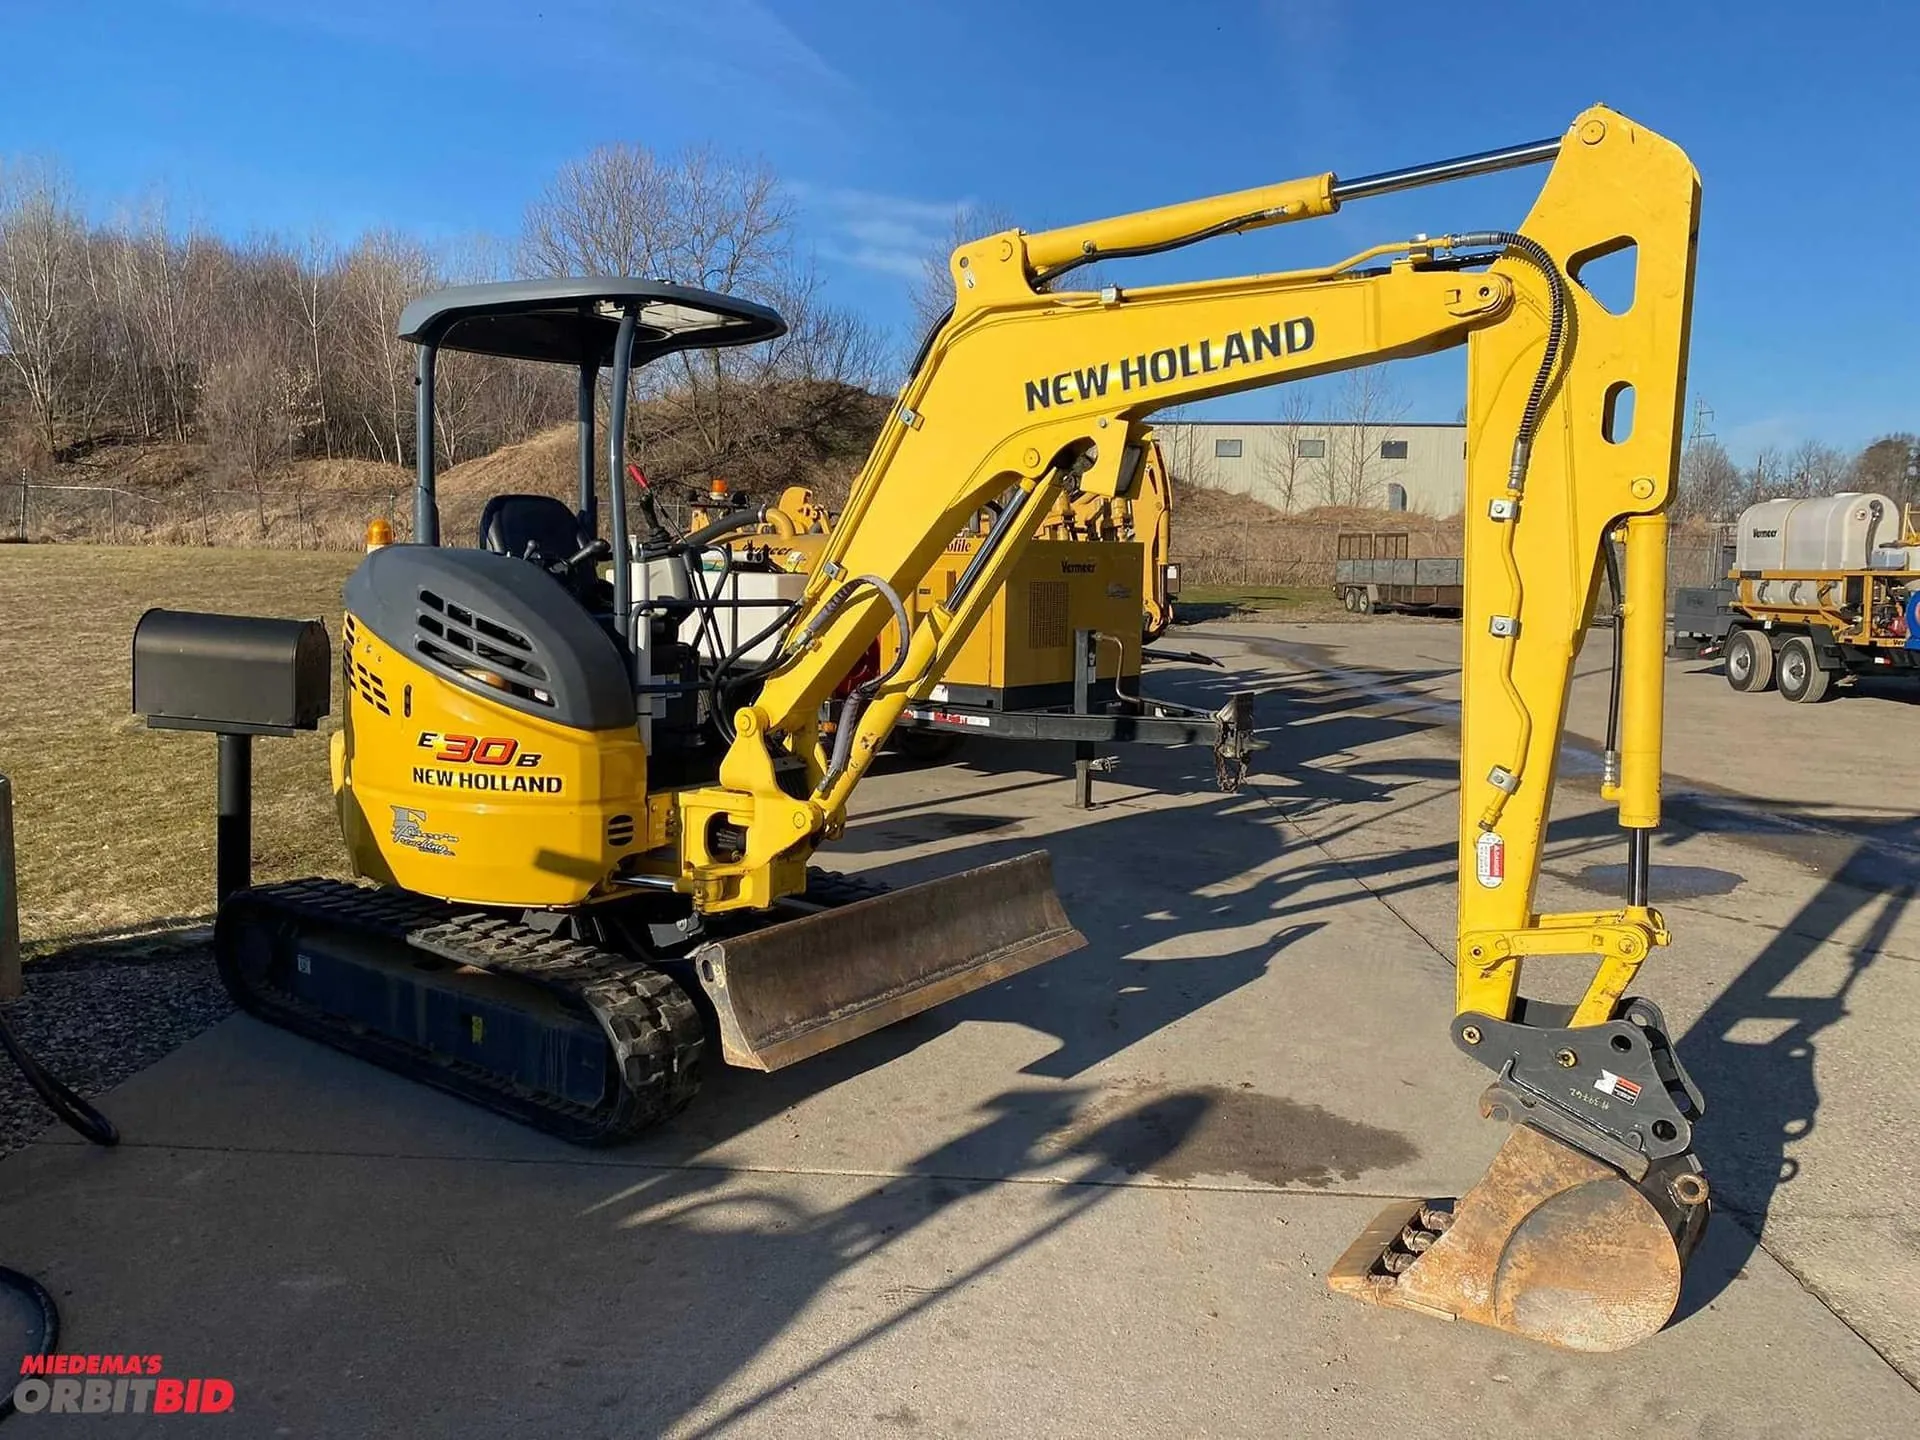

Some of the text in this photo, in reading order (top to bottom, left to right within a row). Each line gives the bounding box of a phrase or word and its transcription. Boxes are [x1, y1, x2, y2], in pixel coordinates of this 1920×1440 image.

[1024, 316, 1315, 412] NEW HOLLAND
[1061, 560, 1097, 574] Vermeer
[413, 767, 563, 793] NEW HOLLAND
